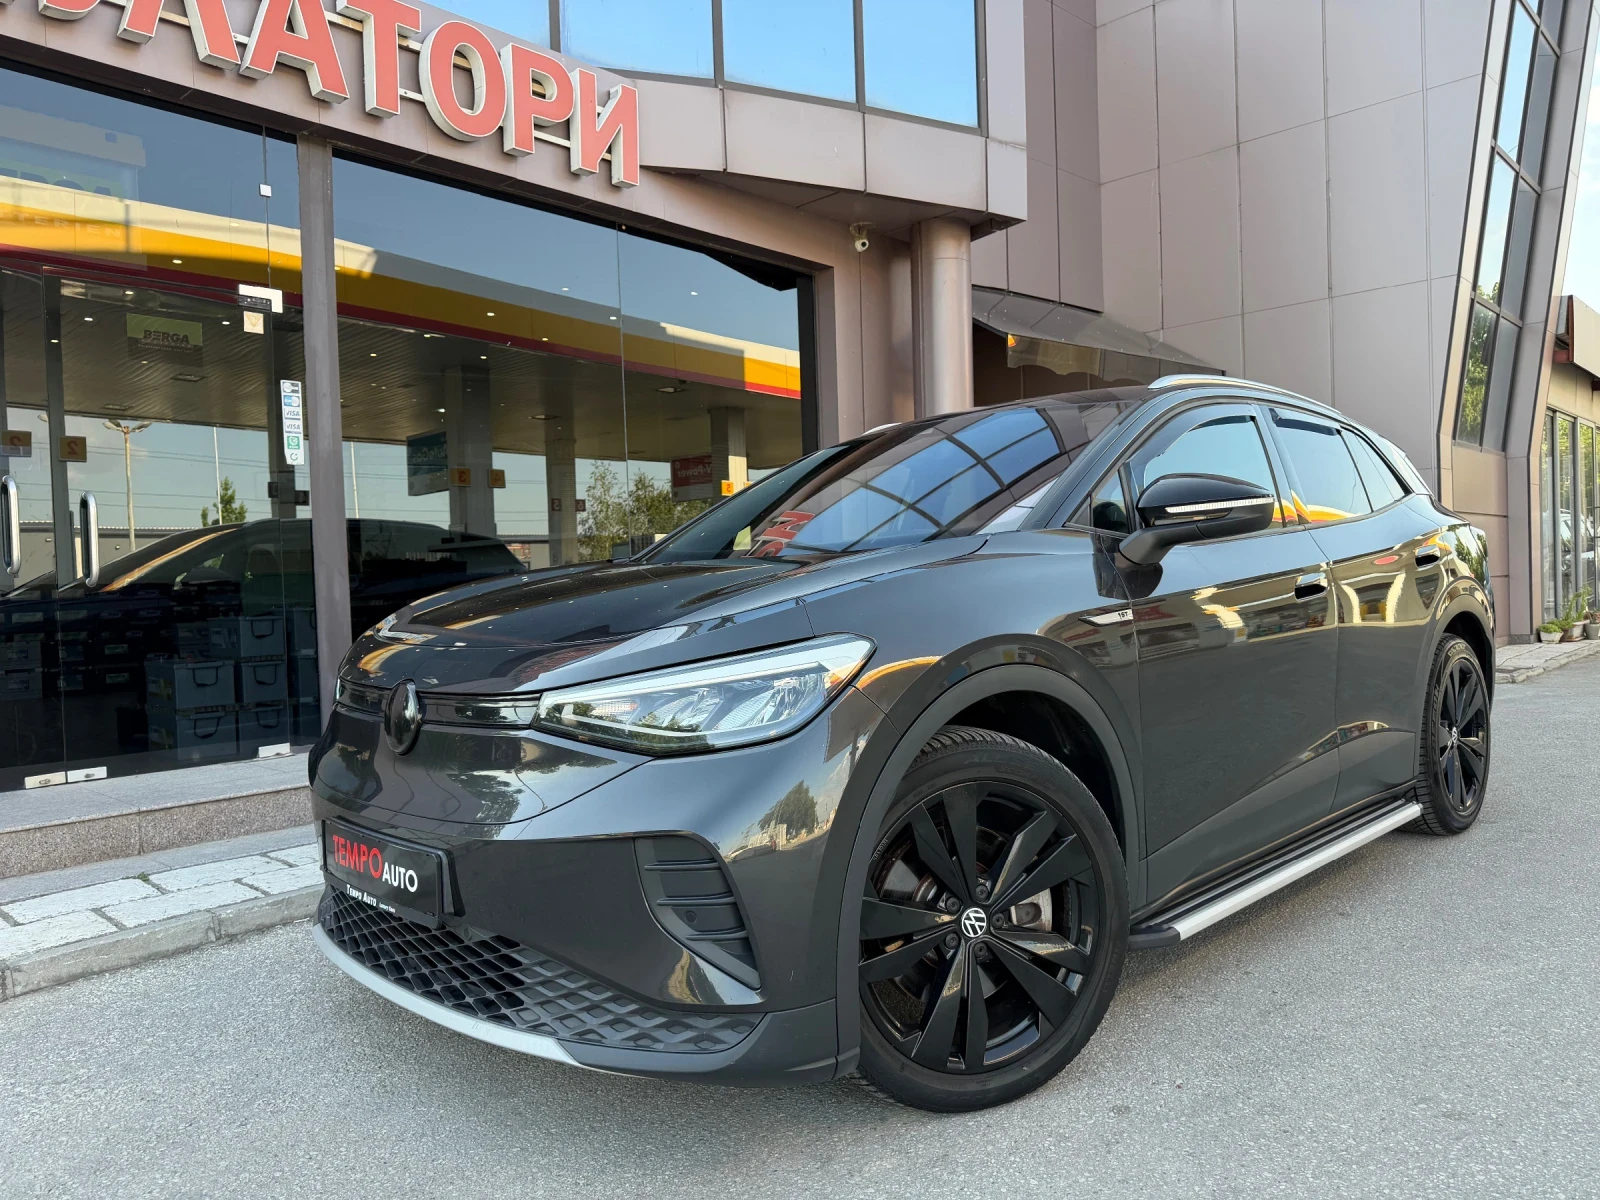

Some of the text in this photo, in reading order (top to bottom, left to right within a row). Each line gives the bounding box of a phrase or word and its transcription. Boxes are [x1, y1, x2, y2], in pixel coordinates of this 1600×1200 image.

[37, 0, 640, 188] АТОРИ
[143, 329, 190, 344] BERGA
[1118, 611, 1128, 619] 1ST
[382, 862, 418, 893] AUTO
